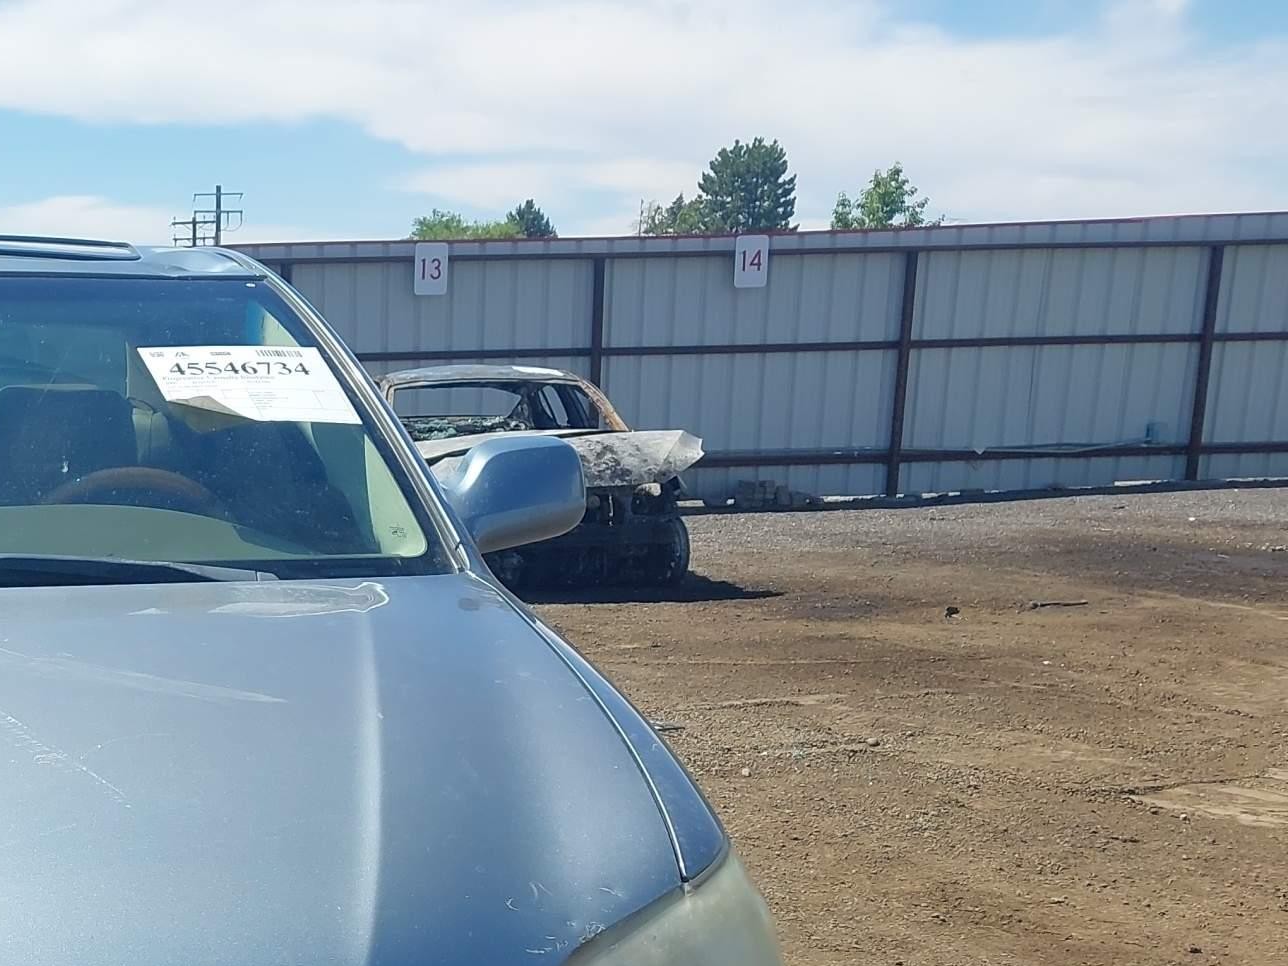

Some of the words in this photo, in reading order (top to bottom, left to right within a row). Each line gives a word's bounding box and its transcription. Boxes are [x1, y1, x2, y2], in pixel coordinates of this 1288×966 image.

[420, 257, 442, 281] 13
[741, 249, 762, 272] 14
[169, 361, 311, 376] 45546734
